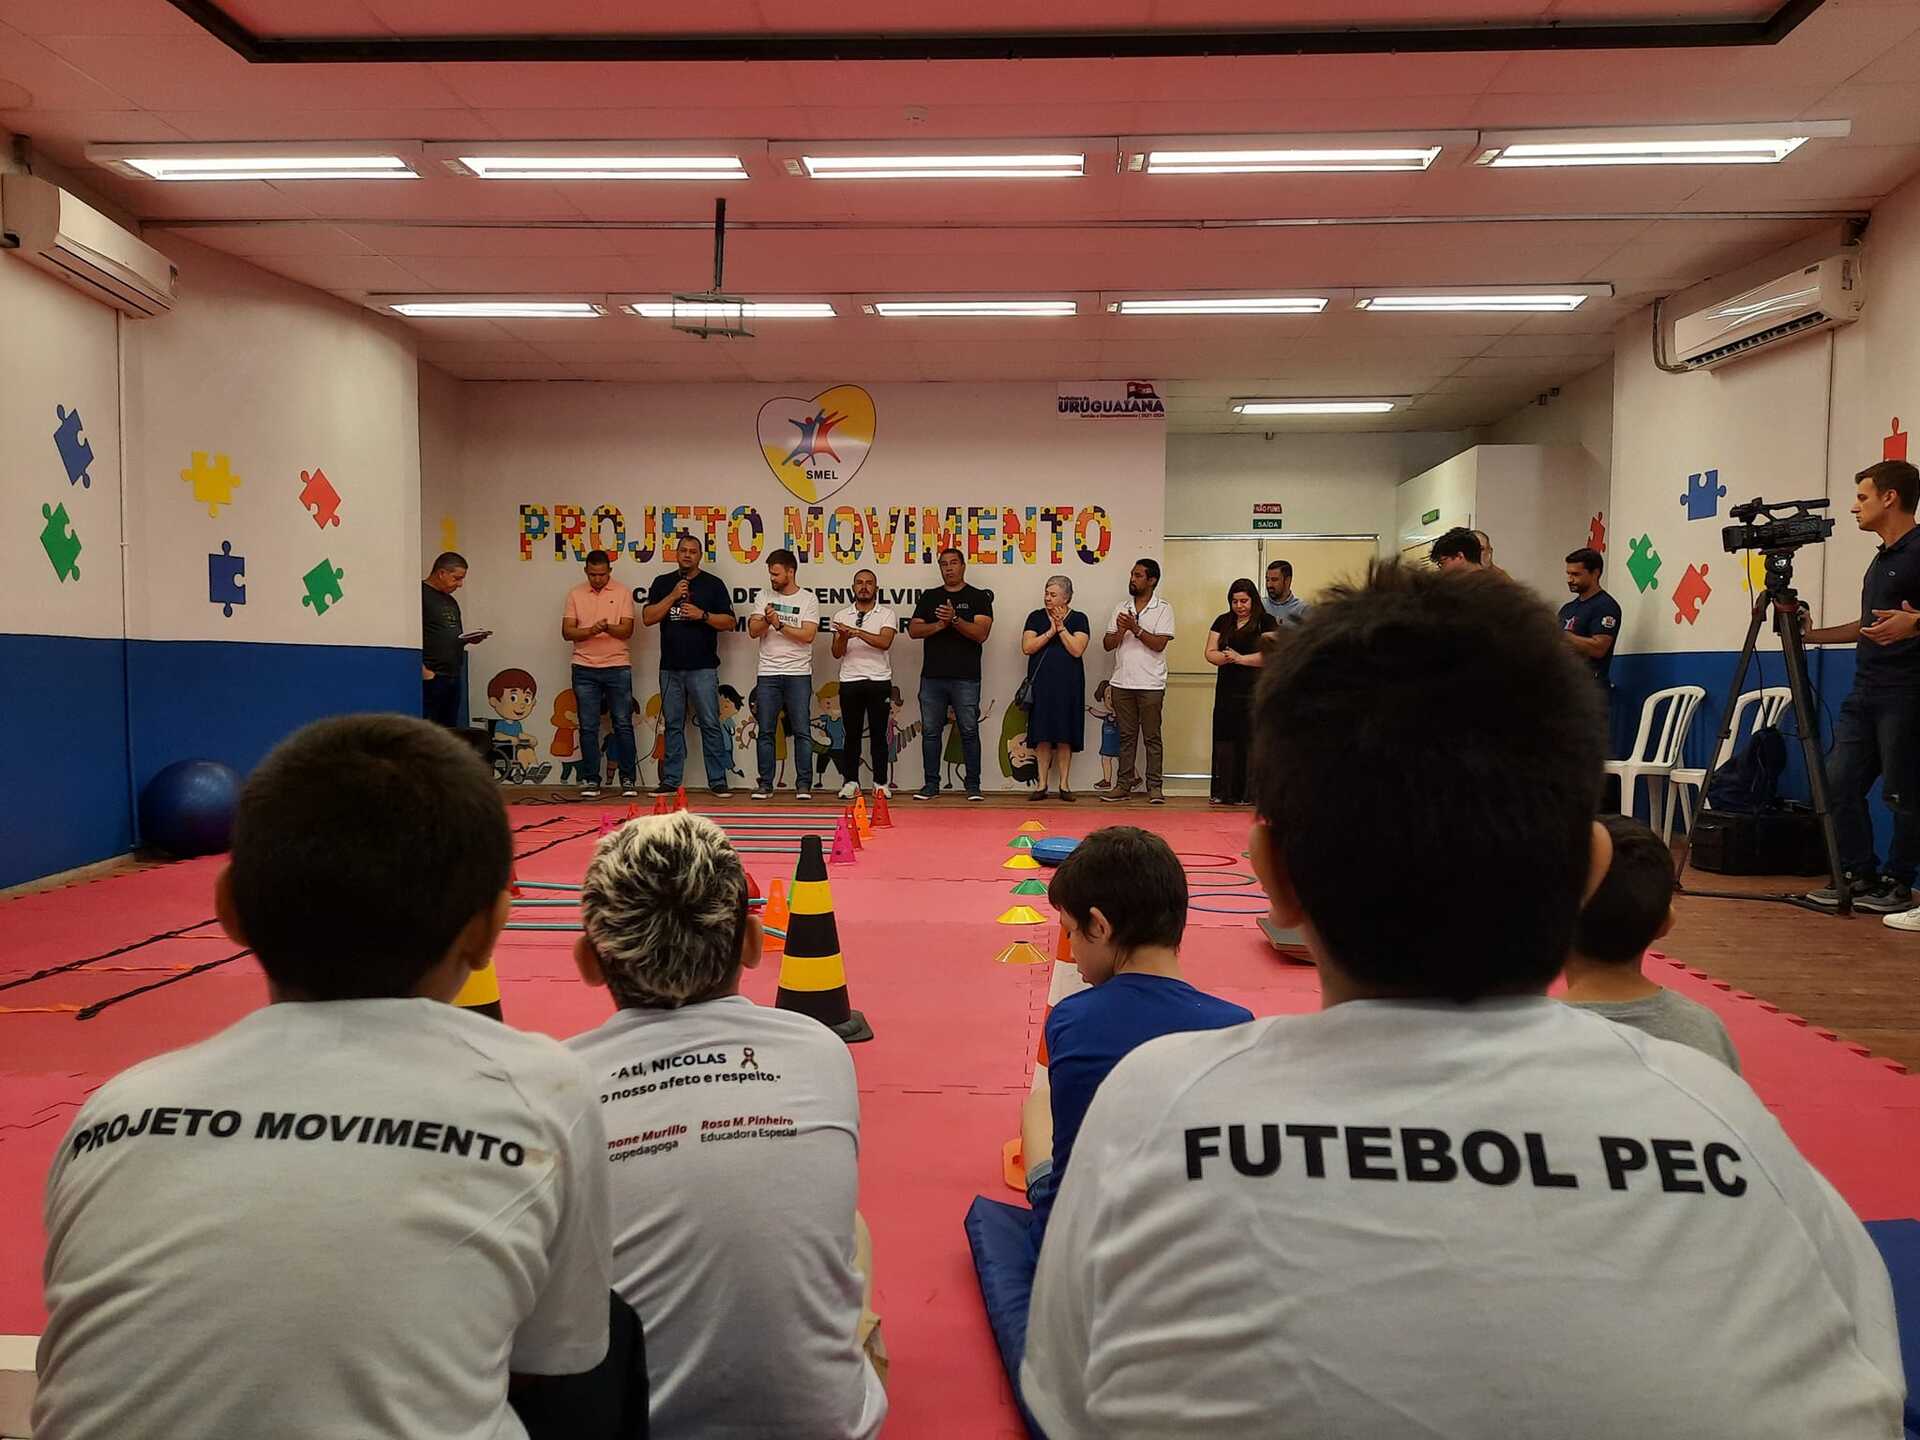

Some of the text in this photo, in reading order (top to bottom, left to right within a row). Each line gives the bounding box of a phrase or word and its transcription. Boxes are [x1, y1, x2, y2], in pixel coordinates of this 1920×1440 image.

[1058, 399, 1165, 413] URUGUAIANA
[806, 470, 839, 480] SMEL
[519, 504, 1112, 565] PROJETO MOVIMENTO
[651, 1053, 727, 1073] NICOLAS
[611, 1083, 657, 1101] nosso
[659, 1075, 701, 1090] afeto
[703, 1074, 712, 1083] e
[701, 1119, 731, 1130] Rosa
[748, 1115, 794, 1126] Pinheiro
[72, 1107, 526, 1168] PROJETO MOVIMENTO
[641, 1124, 688, 1142] Murillo
[700, 1128, 798, 1143] Educadora Especial
[1184, 1123, 1749, 1198] FUTEBOL PEC
